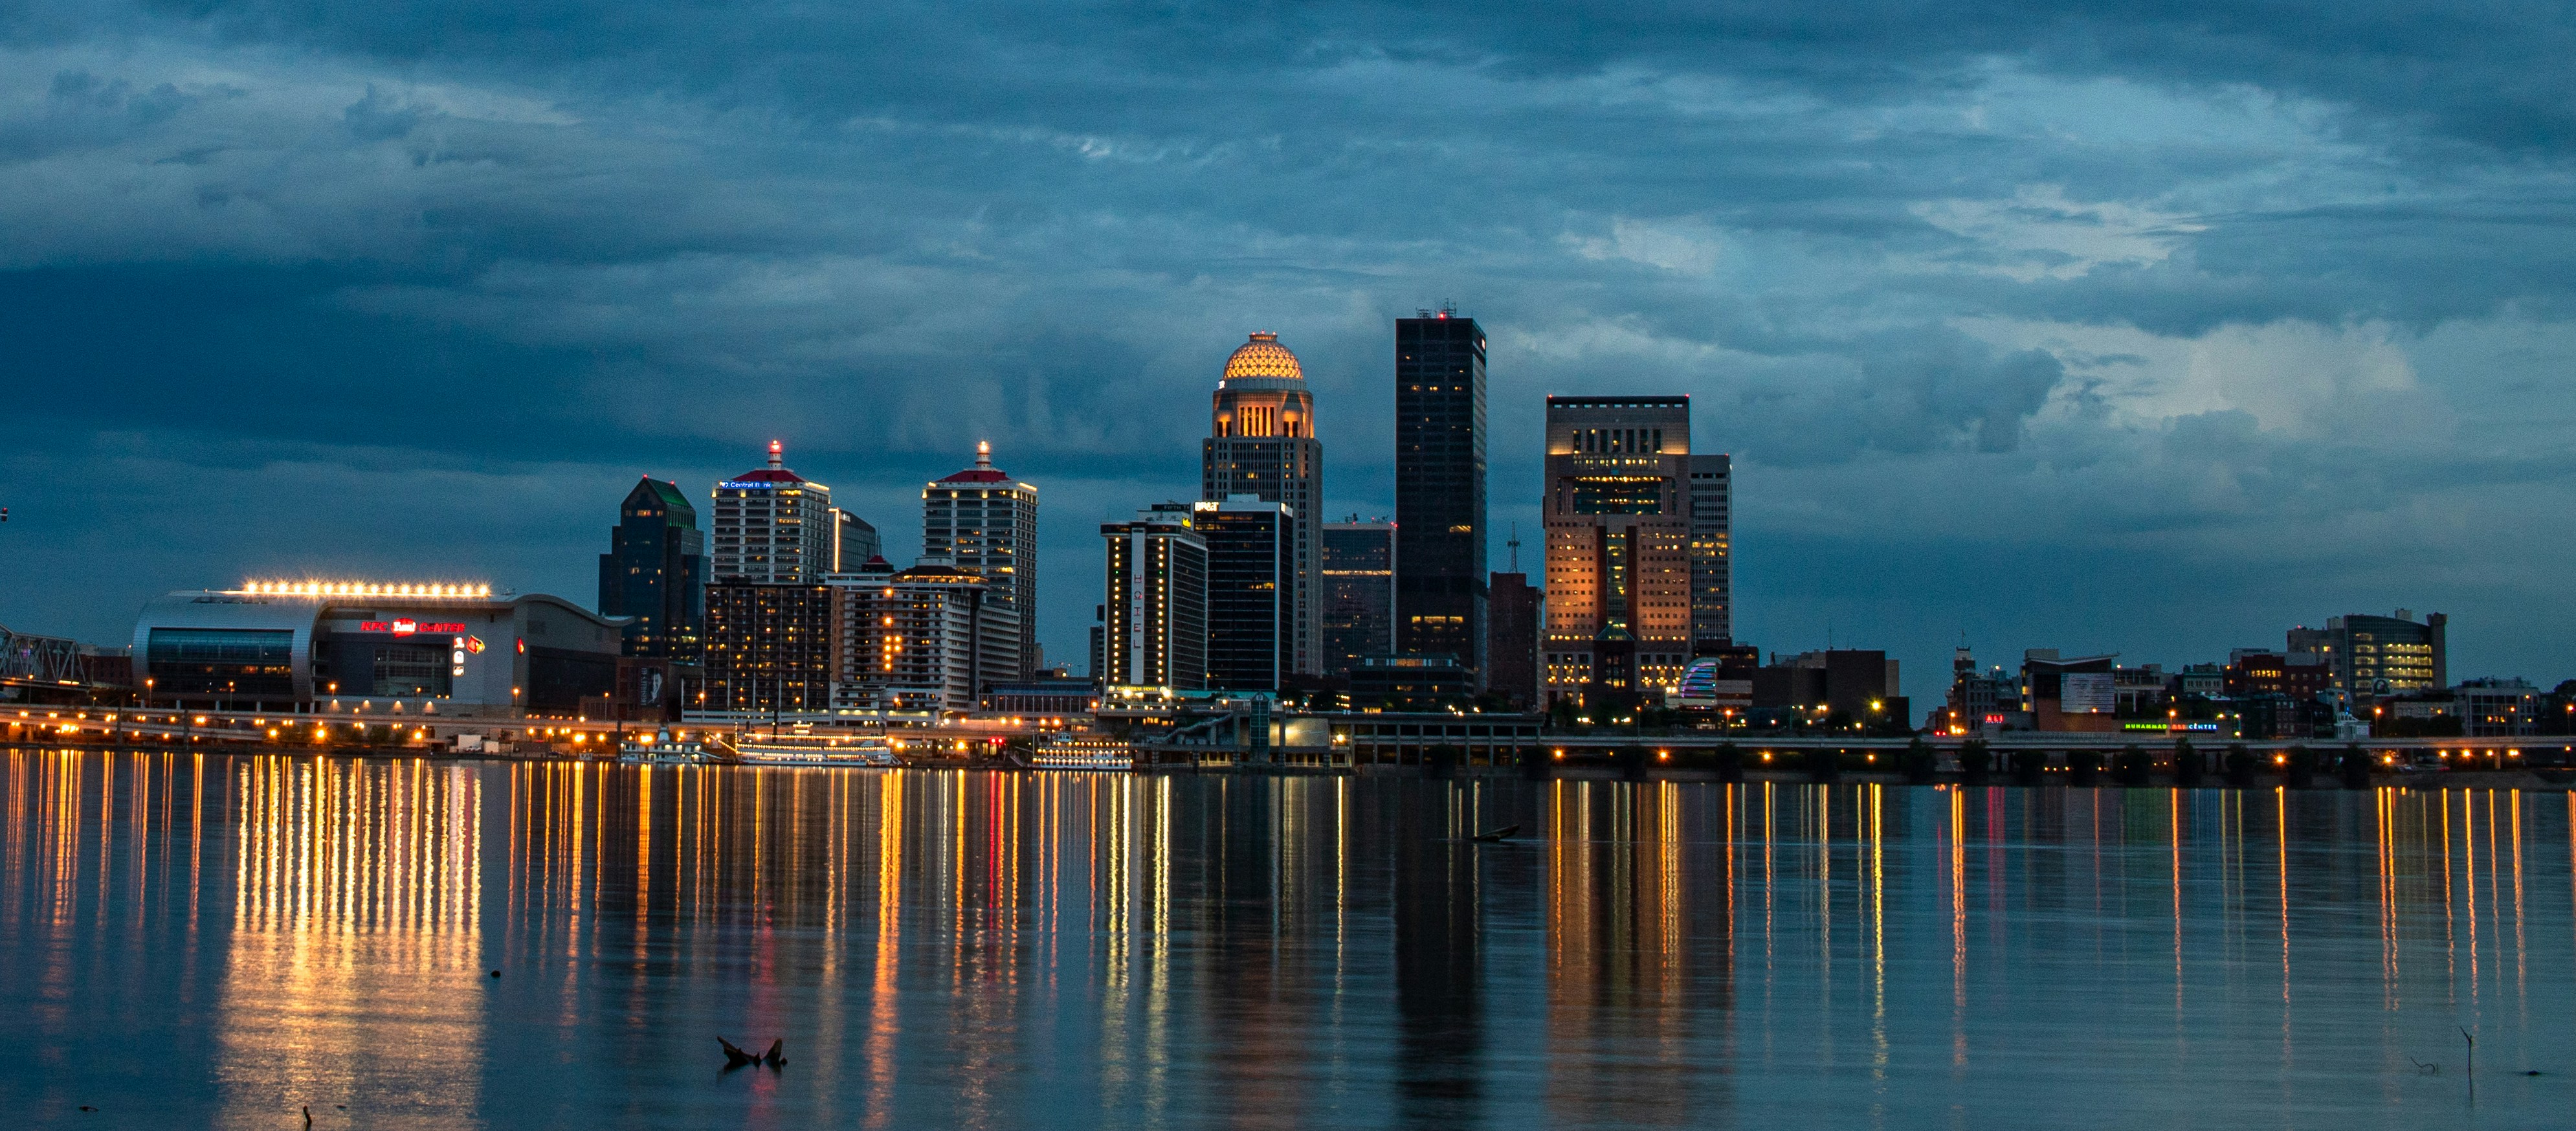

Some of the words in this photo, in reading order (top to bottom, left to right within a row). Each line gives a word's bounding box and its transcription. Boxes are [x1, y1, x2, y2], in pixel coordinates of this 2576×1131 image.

[361, 621, 388, 631] KFC
[419, 622, 465, 633] CENTER
[1134, 574, 1142, 649] HOTEL
